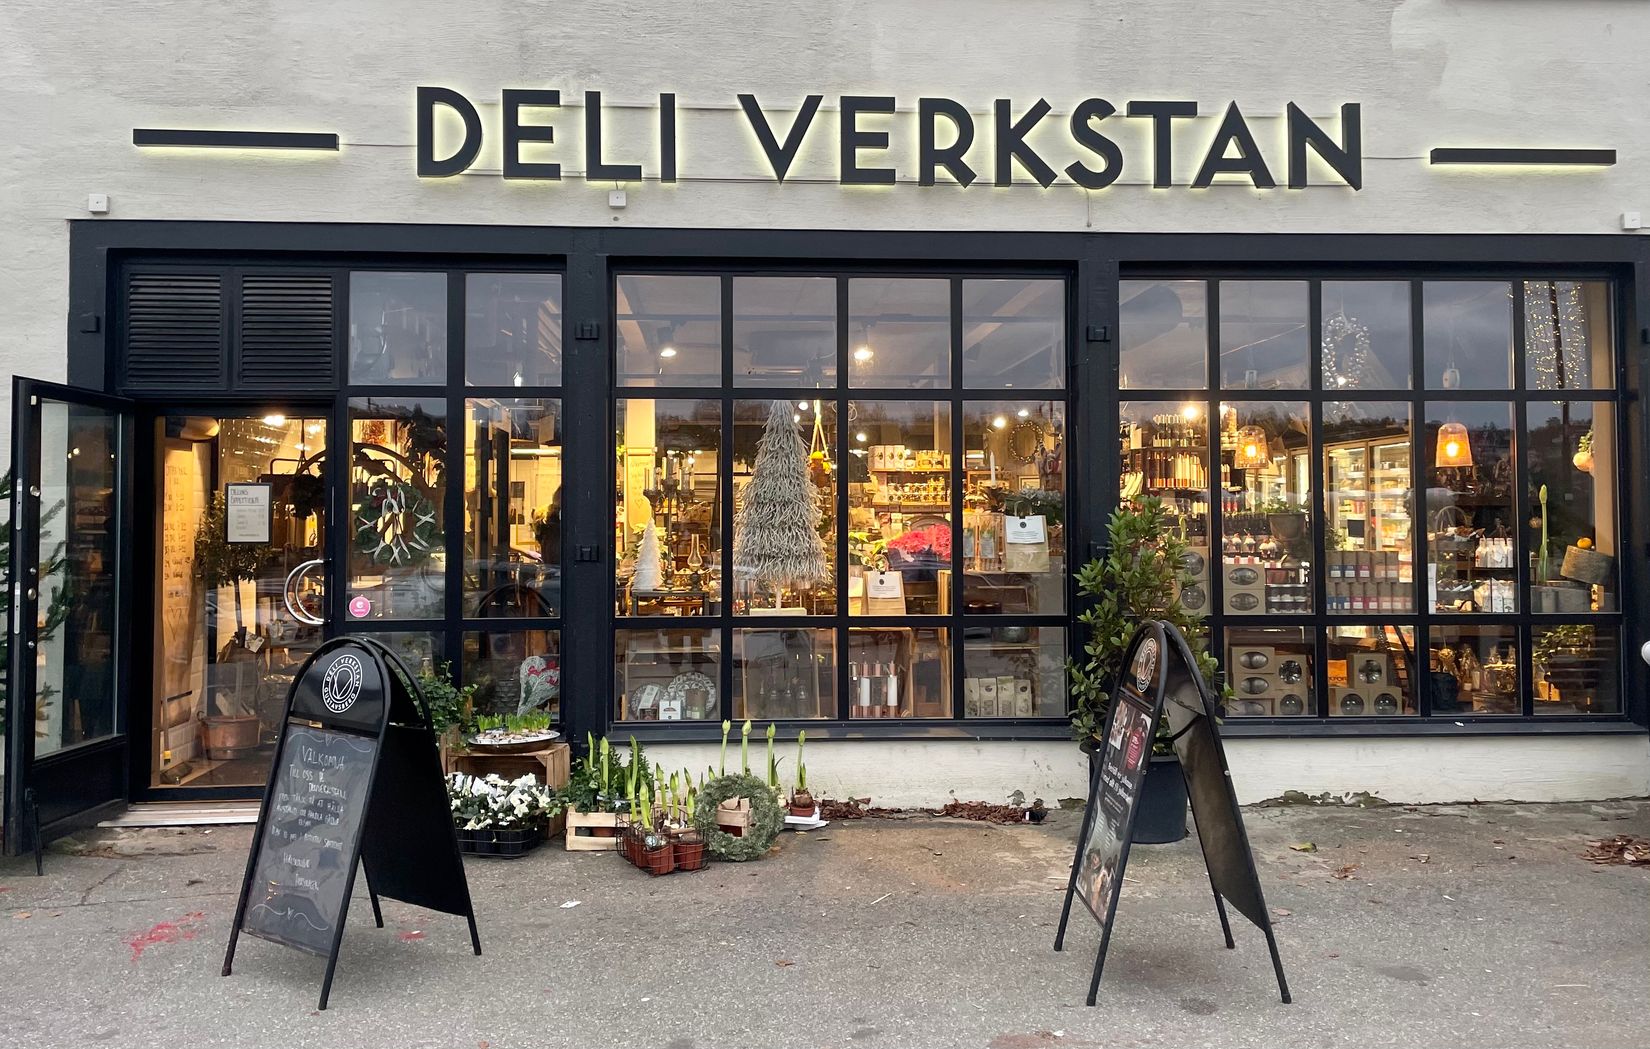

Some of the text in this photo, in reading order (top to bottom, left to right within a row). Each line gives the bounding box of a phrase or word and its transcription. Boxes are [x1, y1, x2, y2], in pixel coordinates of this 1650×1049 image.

[417, 86, 1362, 191] DELI VERKSTAN
[326, 657, 361, 687] DELI VERKSTAN
[324, 686, 356, 711] GUSTAVSBERG
